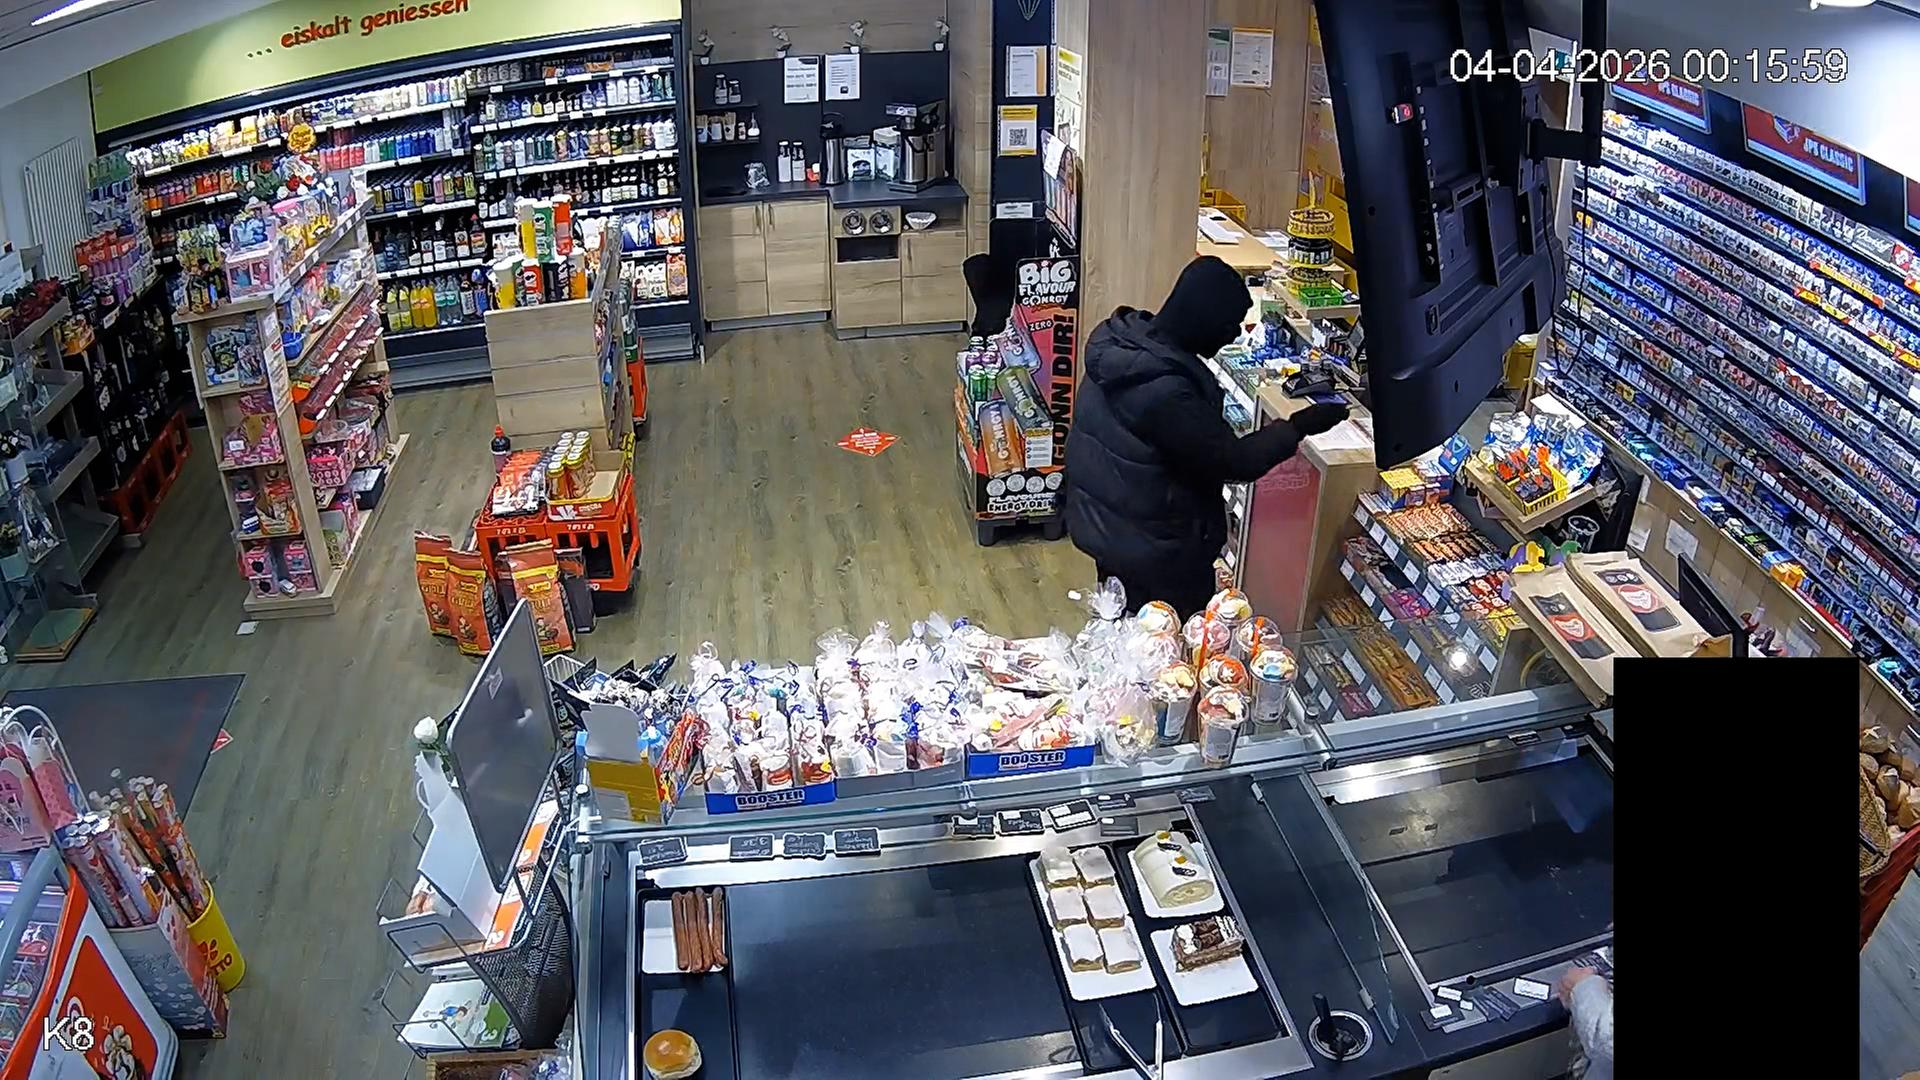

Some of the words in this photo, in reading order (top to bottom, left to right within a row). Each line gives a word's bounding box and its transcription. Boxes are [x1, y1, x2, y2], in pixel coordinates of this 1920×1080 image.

[280, 15, 352, 49] eiskalt
[360, 0, 469, 36] geniessen
[1820, 143, 1855, 172] CLASSIC
[1018, 281, 1076, 296] FLAVOUR
[1029, 319, 1054, 332] ZERO
[1052, 314, 1074, 377] DIR!
[987, 500, 1027, 514] ENERGY
[1000, 751, 1065, 766] BOOSTER
[735, 789, 805, 806] BOOSTER
